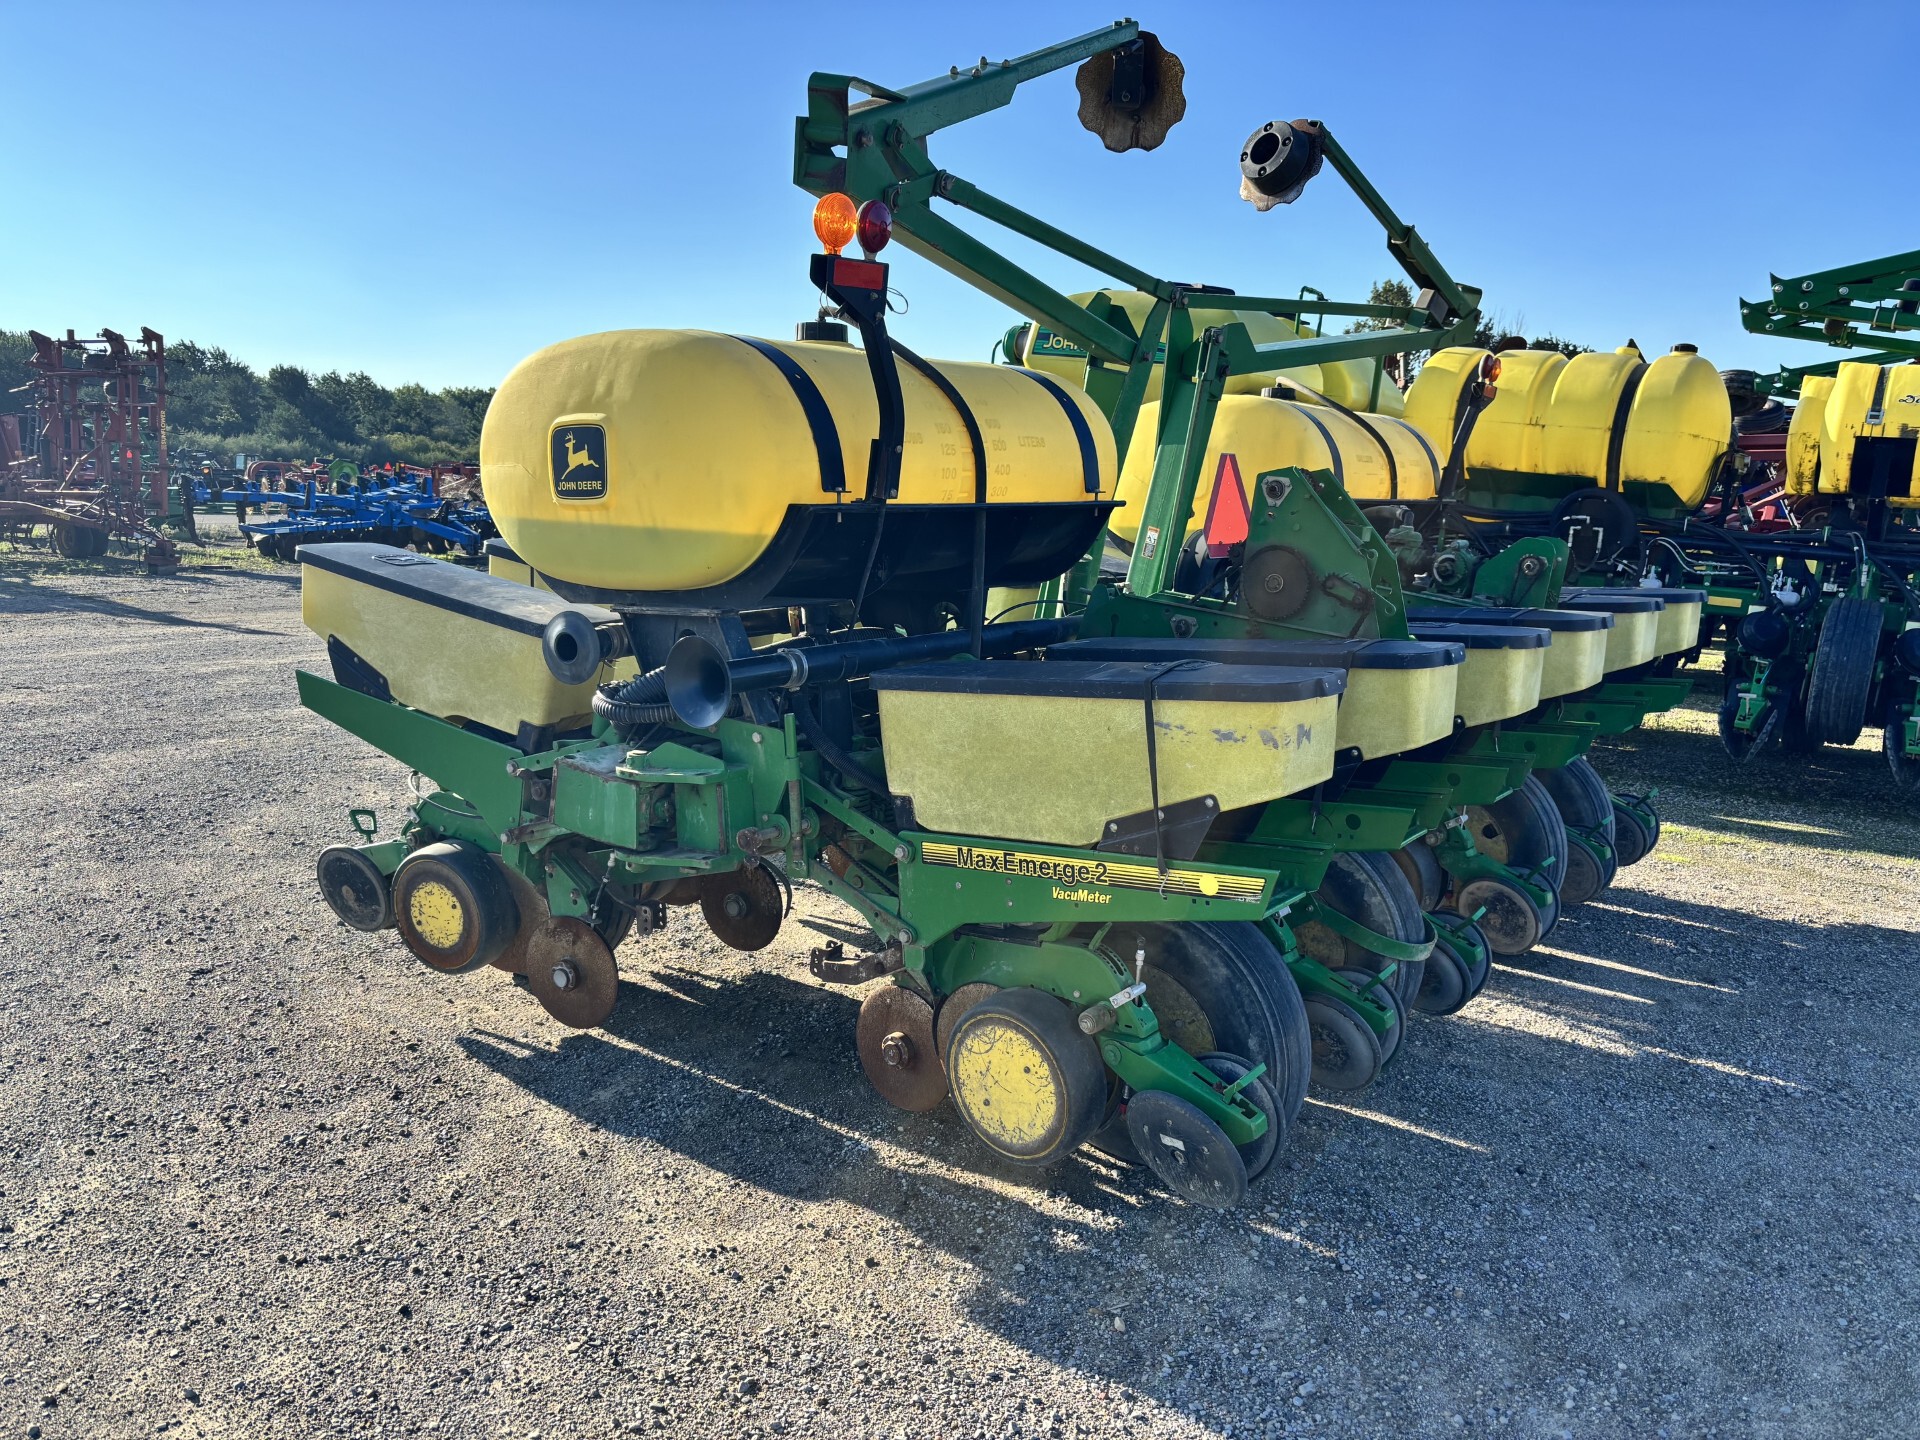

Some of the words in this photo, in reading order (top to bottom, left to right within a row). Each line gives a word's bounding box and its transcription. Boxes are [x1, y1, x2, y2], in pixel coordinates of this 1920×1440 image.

[1043, 334, 1084, 351] JOH
[940, 443, 957, 456] 125
[941, 467, 957, 480] 100
[994, 464, 1011, 476] 400
[558, 481, 577, 491] JOHN
[577, 481, 602, 490] DEERE
[991, 486, 1008, 497] 300
[956, 847, 1092, 886] MaxEmerge
[1094, 862, 1109, 885] 2
[1052, 886, 1113, 904] VacuMeter
